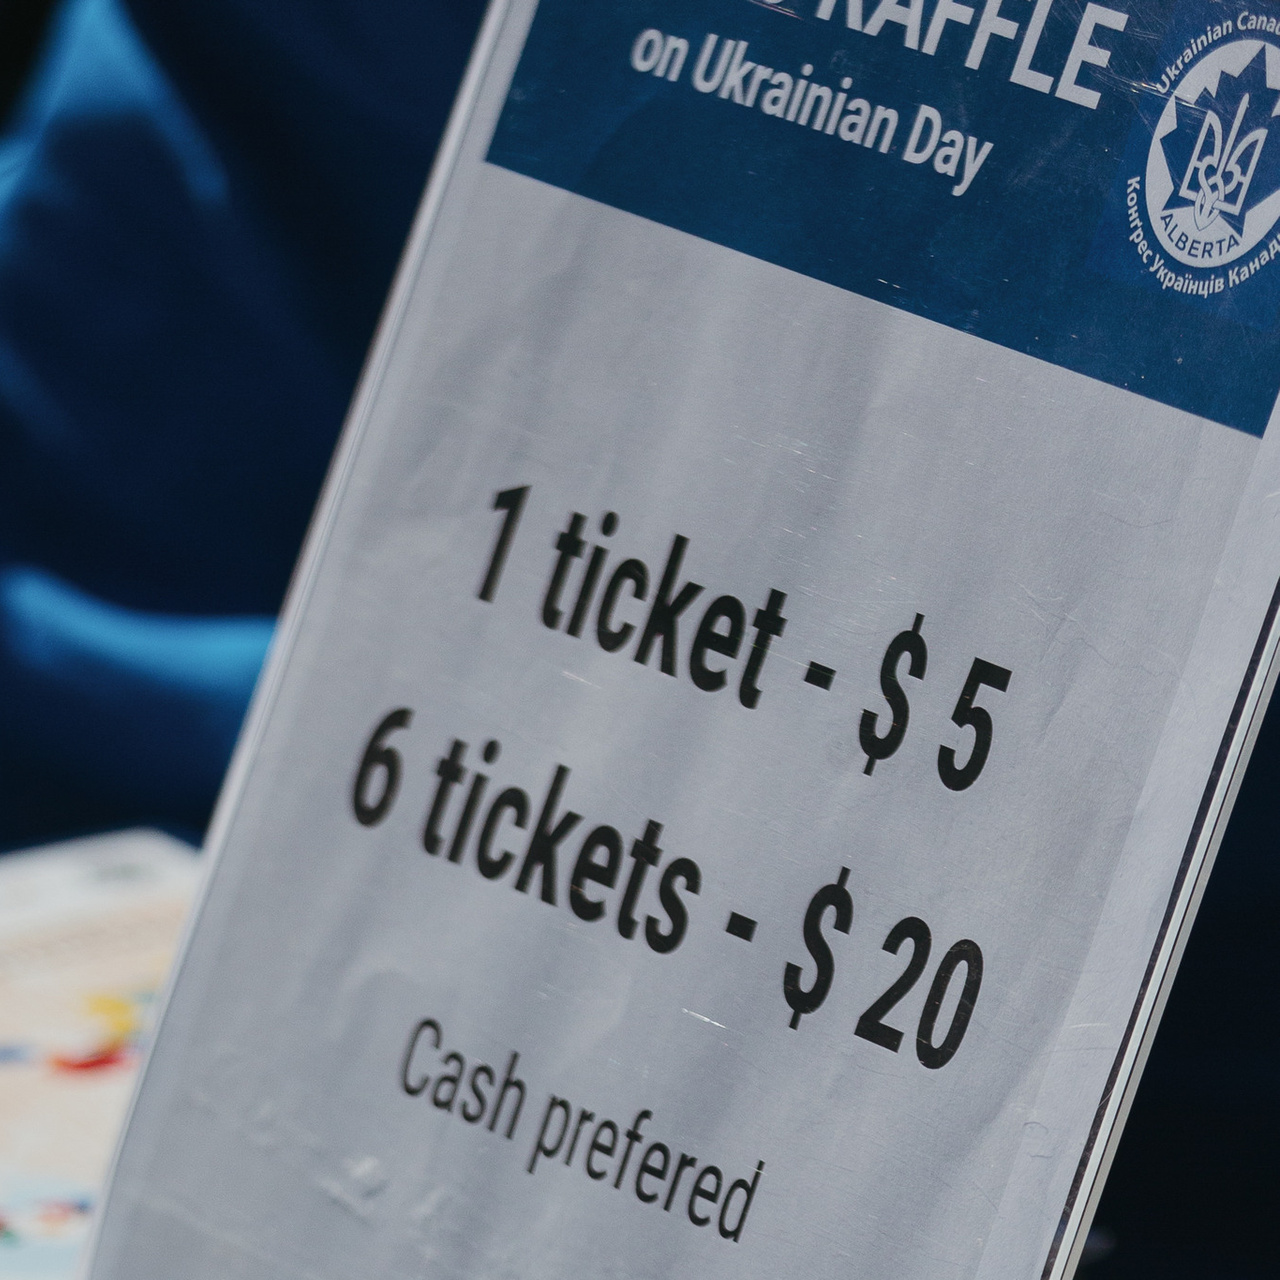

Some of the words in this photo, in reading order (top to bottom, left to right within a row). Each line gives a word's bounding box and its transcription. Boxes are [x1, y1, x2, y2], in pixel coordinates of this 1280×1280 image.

[631, 25, 688, 83] on
[692, 32, 900, 156] Ukrainian
[901, 103, 994, 197] Day
[816, 0, 1129, 110] AFFLE
[1157, 20, 1233, 94] Ukrainian
[1149, 254, 1225, 299] Українців
[1228, 233, 1280, 288] Канад
[1160, 213, 1240, 259] ALBERTA
[477, 485, 532, 604] 1
[540, 508, 789, 710] ticket
[803, 661, 836, 691] -
[858, 611, 928, 777] $
[936, 656, 1013, 793] 5
[351, 706, 415, 828] 6
[422, 737, 703, 955] tickets
[725, 911, 758, 942] -
[782, 865, 854, 1030] $
[854, 915, 984, 1070] 20
[401, 1017, 526, 1140] Cash
[527, 1092, 766, 1244] prefered
